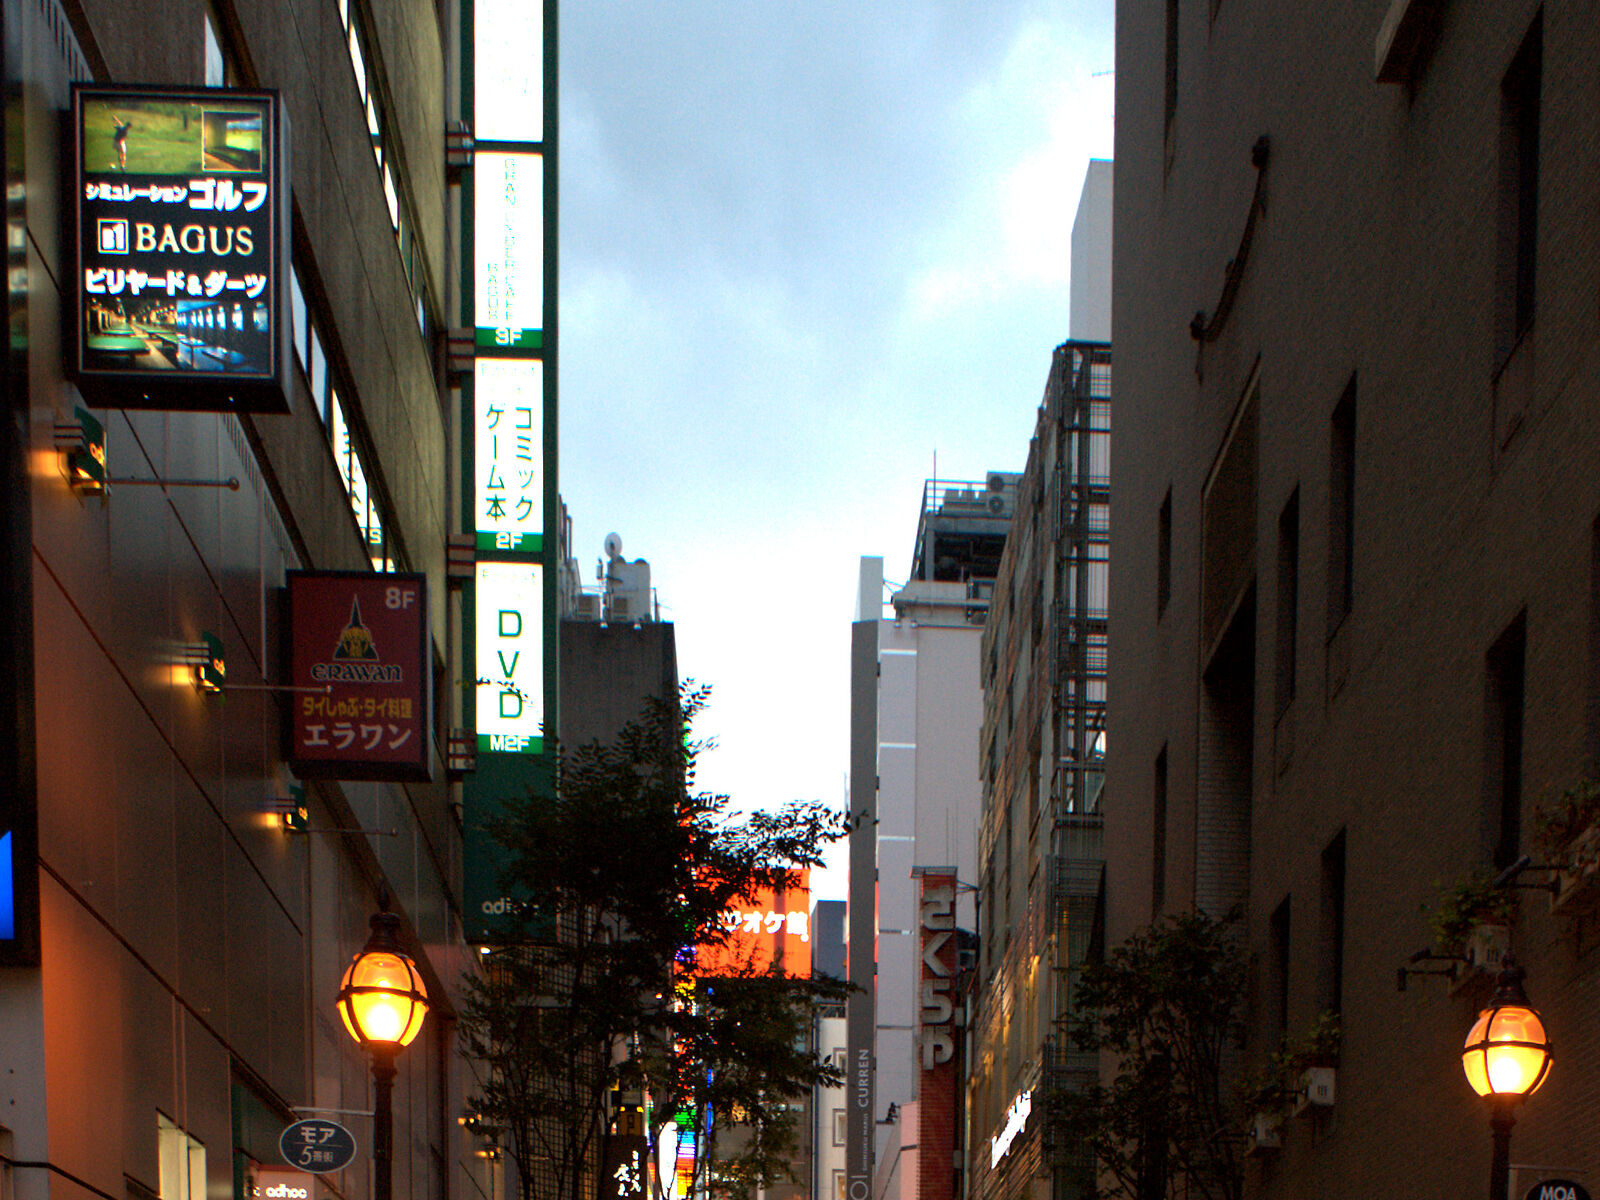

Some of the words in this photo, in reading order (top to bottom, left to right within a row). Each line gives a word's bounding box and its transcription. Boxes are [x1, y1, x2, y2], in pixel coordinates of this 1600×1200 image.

[135, 223, 255, 257] BAGUS
[515, 406, 534, 522] コミック
[495, 532, 524, 550] 2F
[385, 587, 415, 610] 8F
[497, 609, 523, 719] DVD
[303, 722, 412, 750] エラワン
[490, 734, 531, 752] M2F
[857, 1048, 869, 1109] CURREN
[300, 1126, 337, 1144] モア
